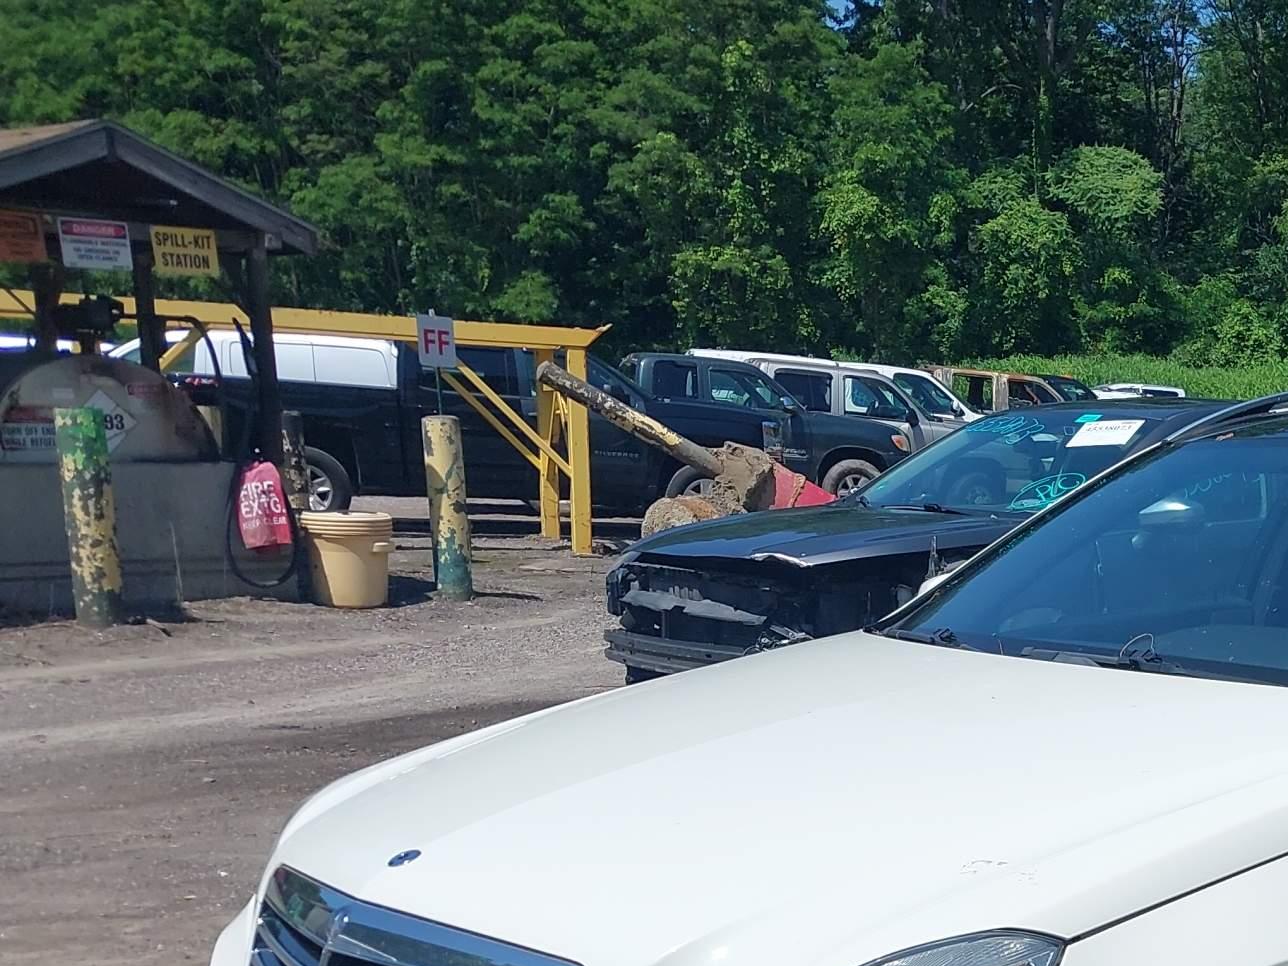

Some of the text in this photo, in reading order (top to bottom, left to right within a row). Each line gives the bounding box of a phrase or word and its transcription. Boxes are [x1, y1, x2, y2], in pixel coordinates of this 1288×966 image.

[154, 231, 211, 249] SPILL-KIT
[161, 251, 211, 270] STATION
[423, 329, 450, 355] FF
[241, 481, 274, 501] FIRE
